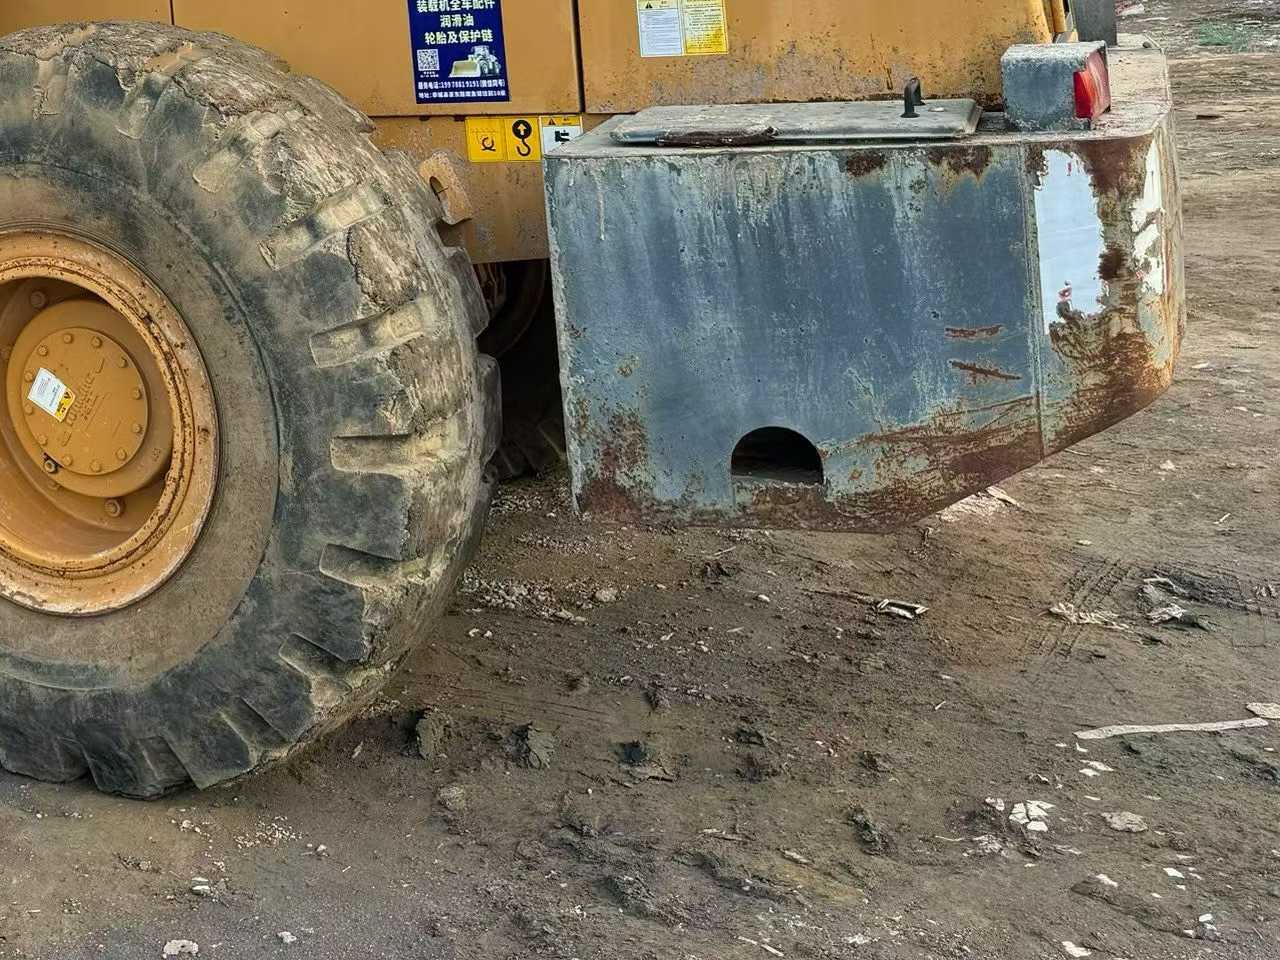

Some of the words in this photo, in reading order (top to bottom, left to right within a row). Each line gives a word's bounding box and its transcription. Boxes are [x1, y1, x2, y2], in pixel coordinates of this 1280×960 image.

[439, 13, 474, 28] 润滑油
[424, 29, 493, 45] 轮胎及保护链
